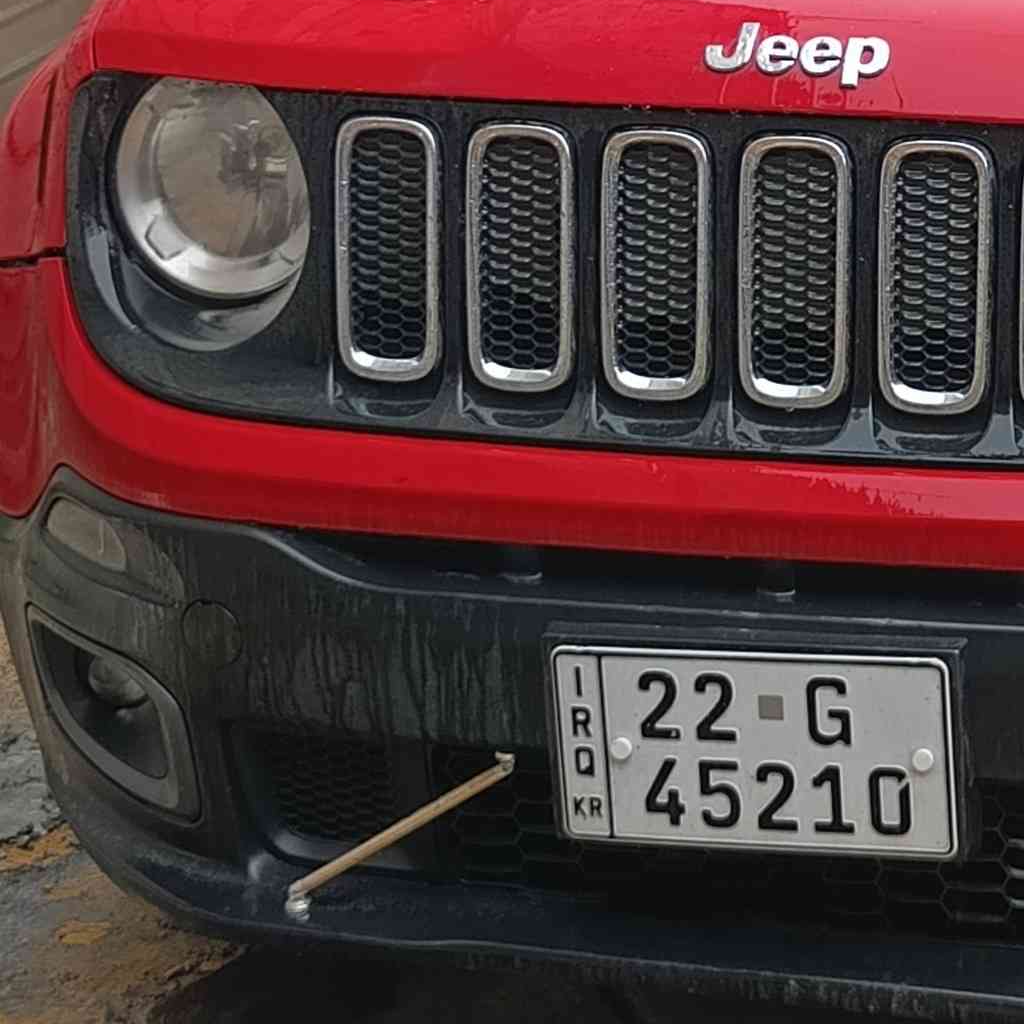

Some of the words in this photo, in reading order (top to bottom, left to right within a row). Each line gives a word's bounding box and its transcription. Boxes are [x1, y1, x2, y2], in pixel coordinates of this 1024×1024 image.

[704, 22, 890, 89] Jeep
[638, 670, 737, 742] 22
[805, 676, 852, 746] G
[573, 796, 602, 821] KR
[645, 757, 912, 835] 45210
